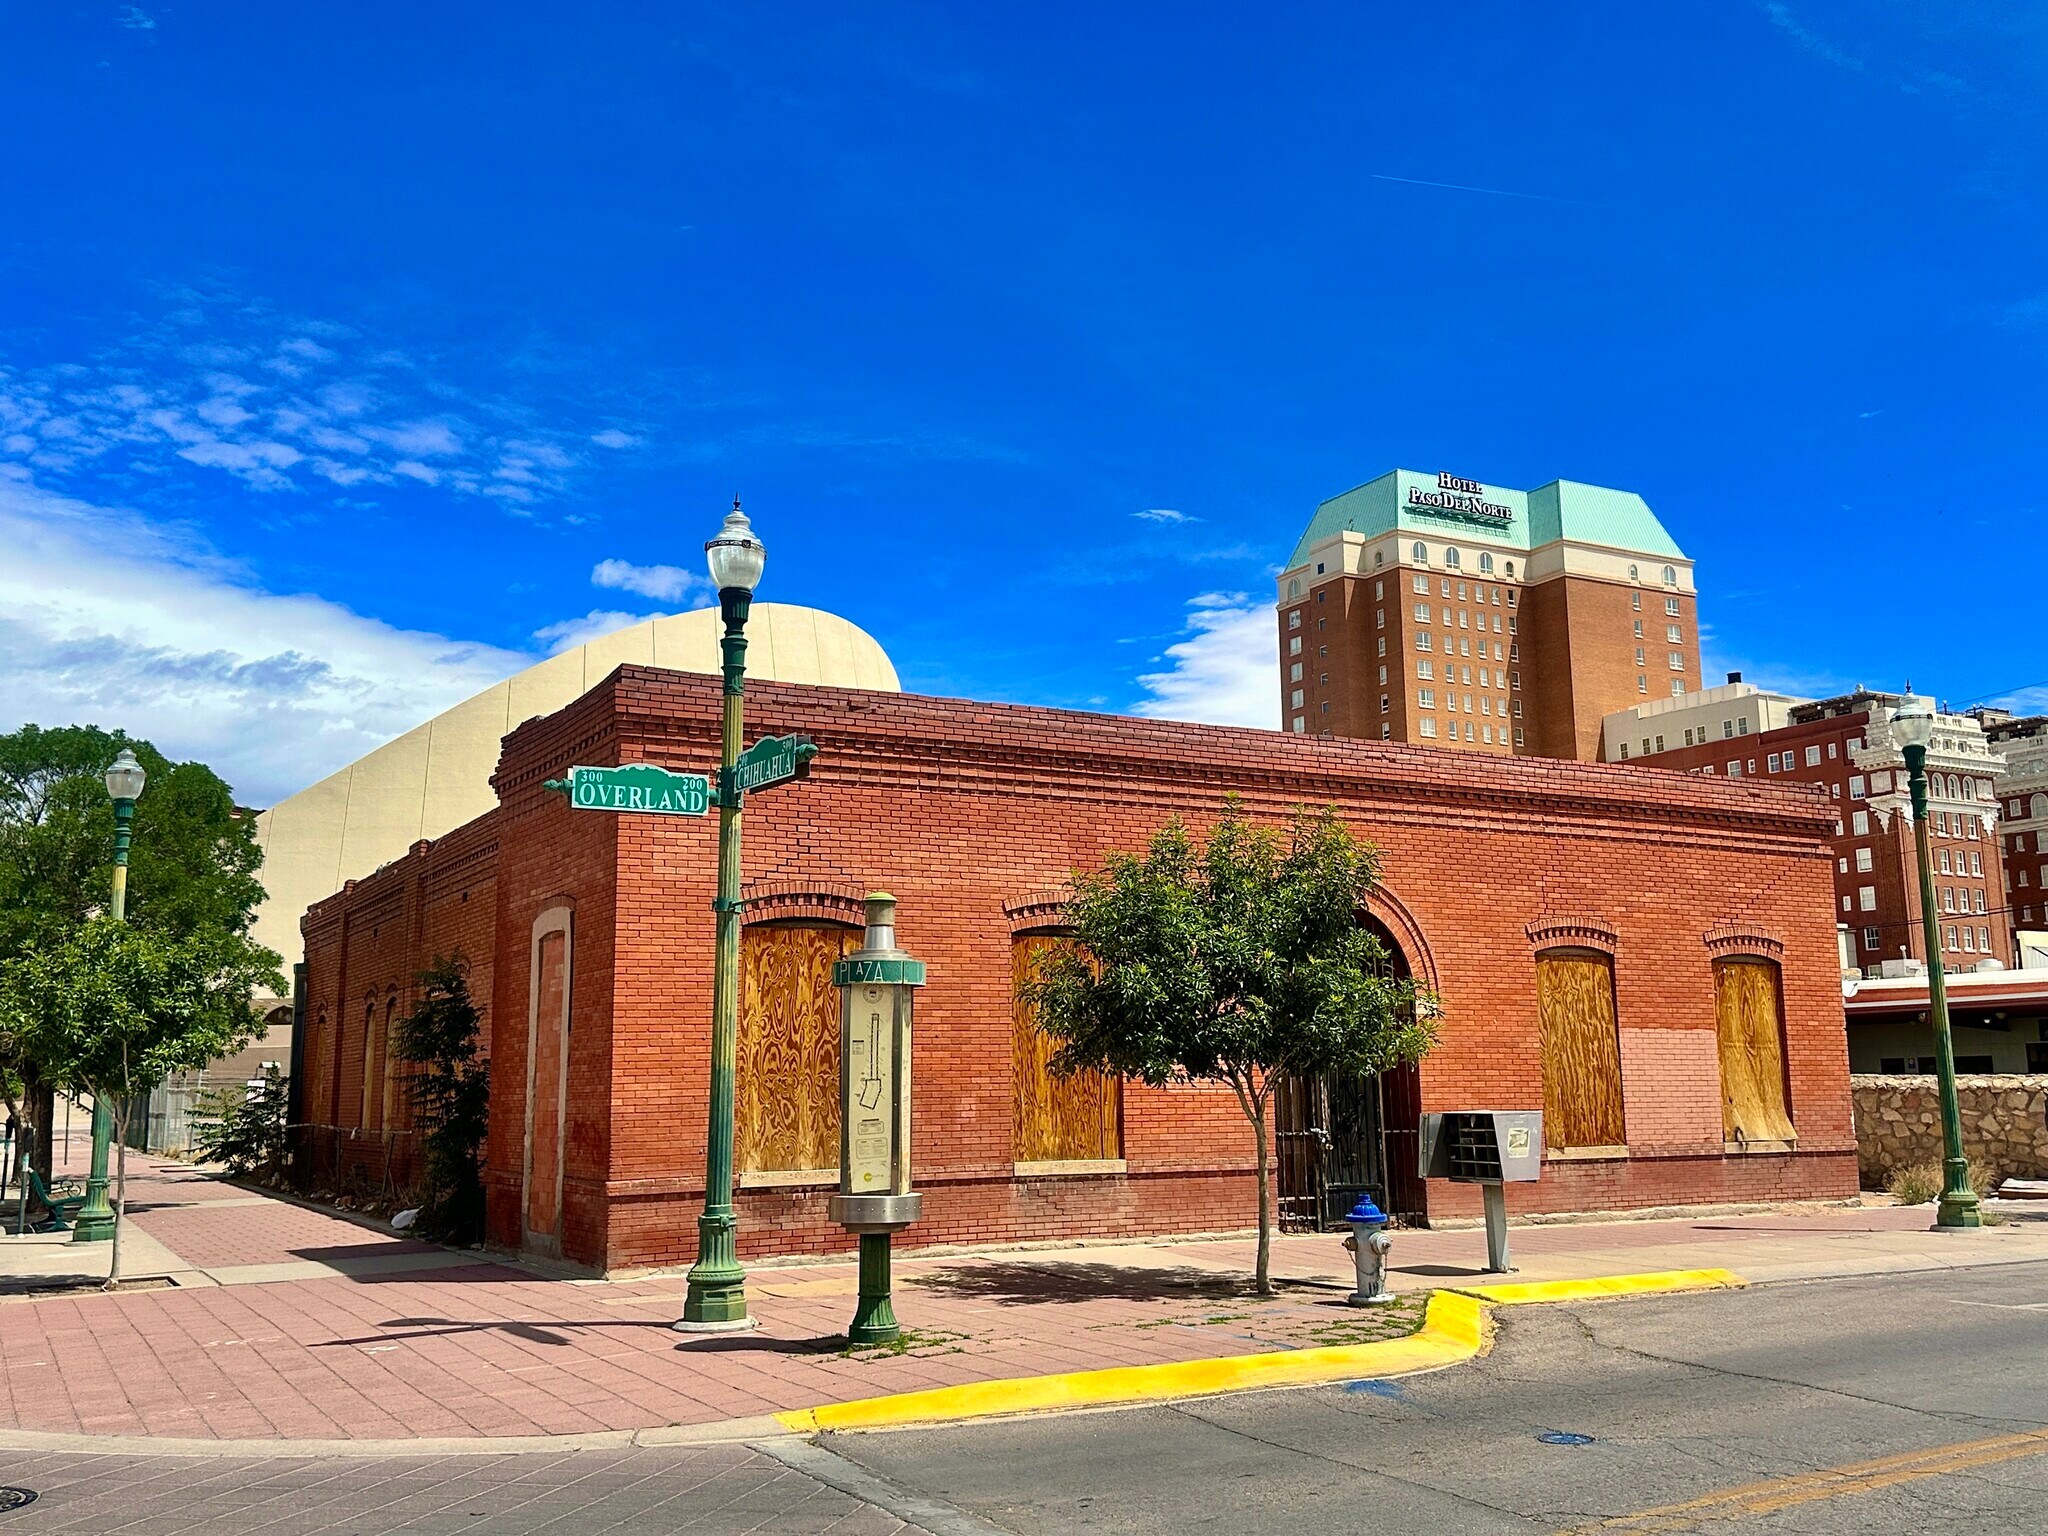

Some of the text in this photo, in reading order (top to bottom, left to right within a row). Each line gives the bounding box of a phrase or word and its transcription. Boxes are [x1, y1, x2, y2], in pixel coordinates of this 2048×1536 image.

[581, 771, 603, 783] 300
[737, 752, 791, 788] CHIHUAHUA
[682, 779, 703, 790] 200
[579, 783, 703, 811] OVERLAND
